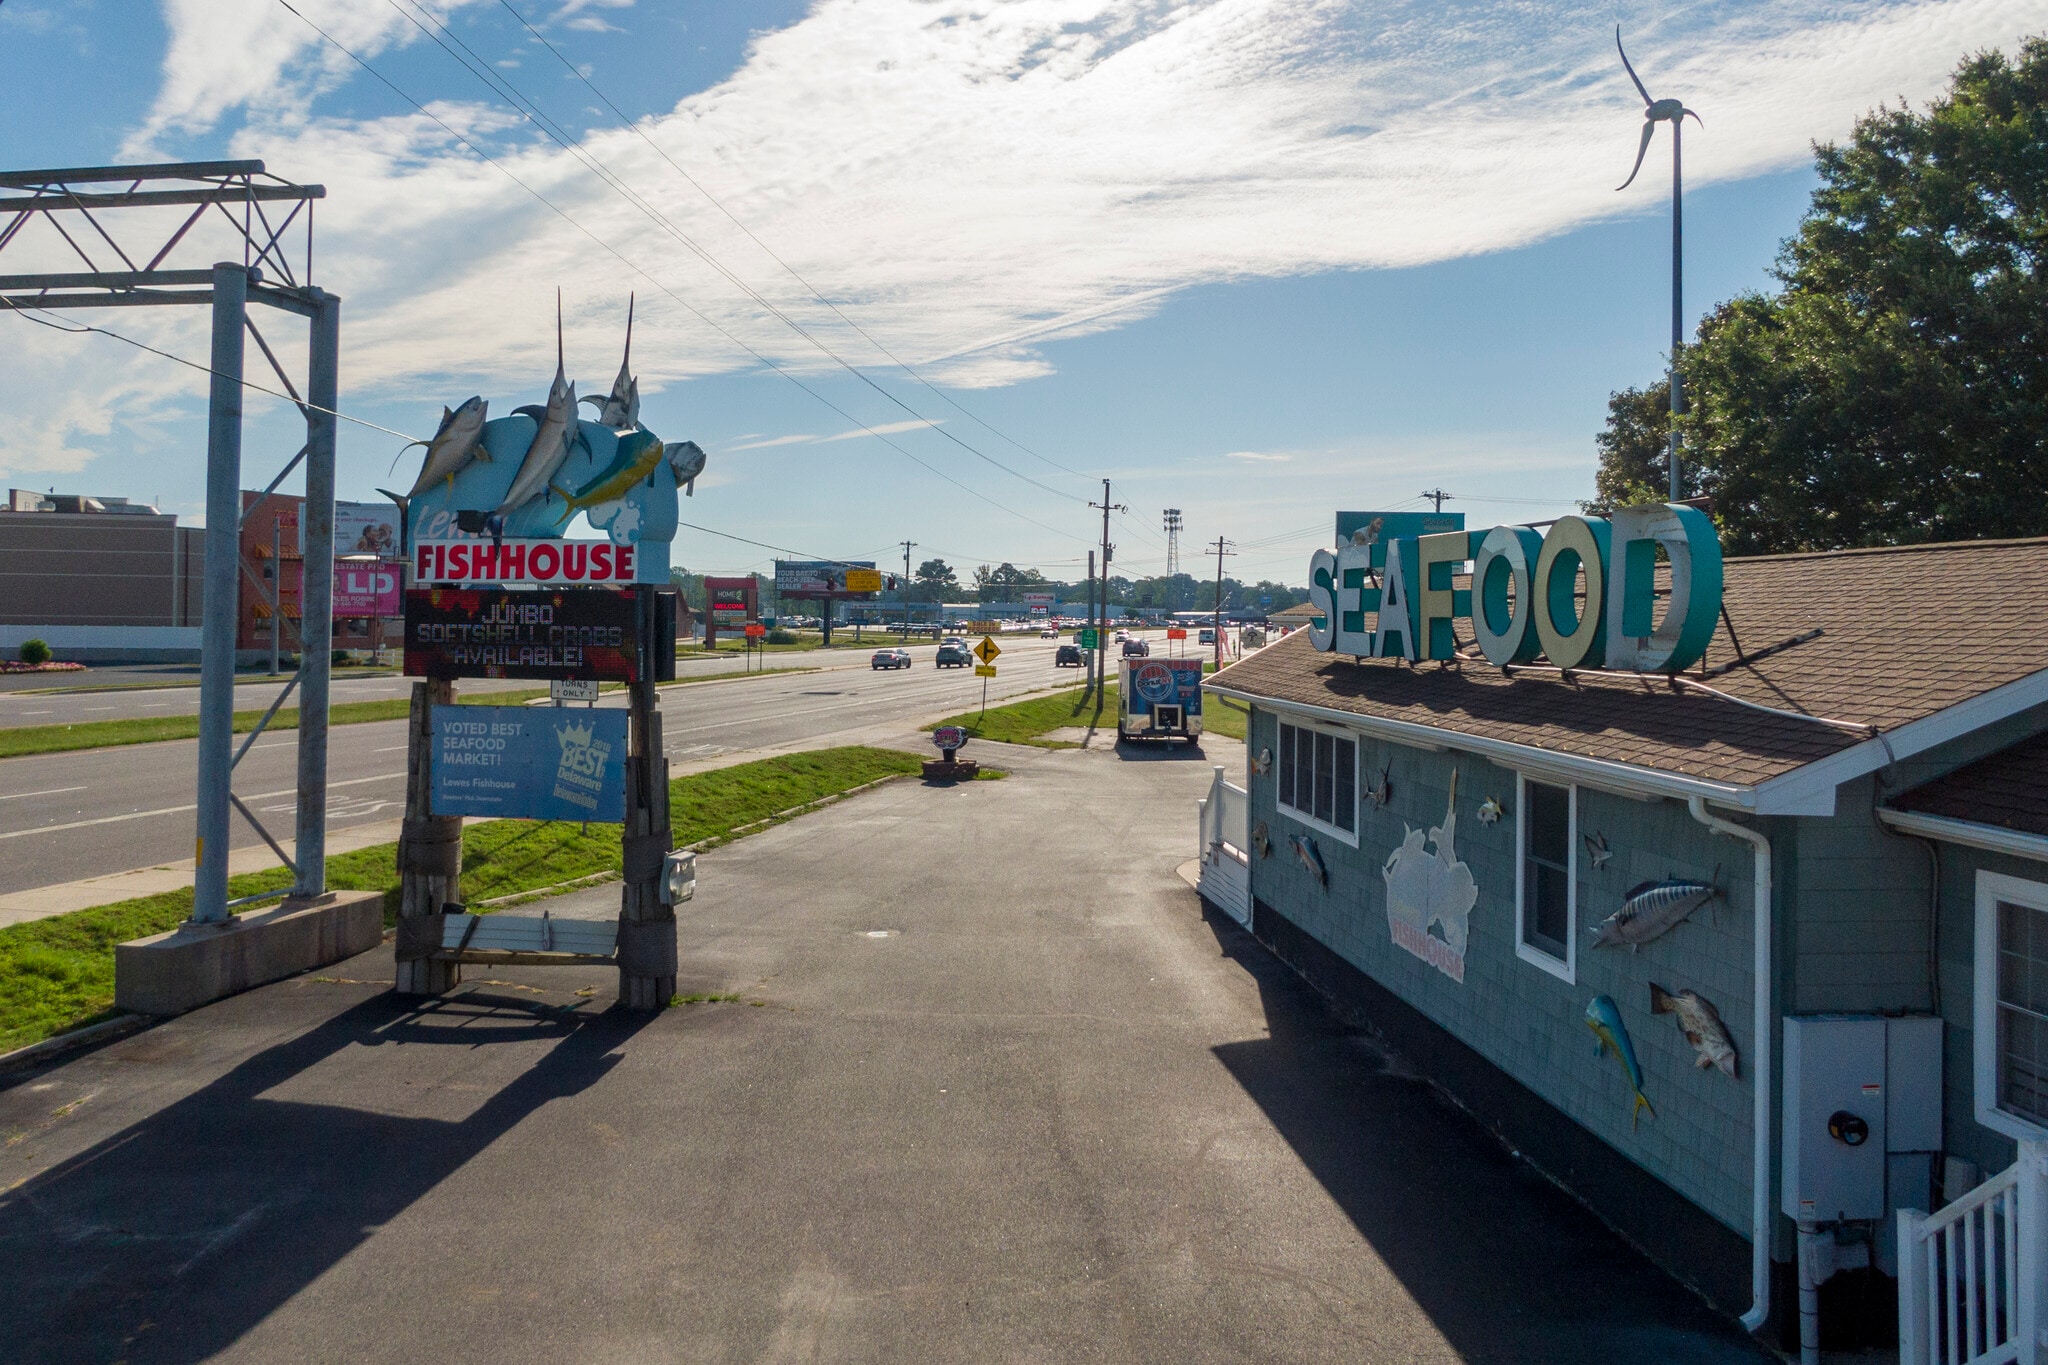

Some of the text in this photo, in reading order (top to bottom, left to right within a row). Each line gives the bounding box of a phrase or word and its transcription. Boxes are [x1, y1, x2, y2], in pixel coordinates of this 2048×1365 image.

[417, 543, 635, 581] FISHHOUSE
[1308, 503, 1720, 672] SEAFOOD
[482, 604, 553, 624] JUMBO
[417, 623, 623, 647] SOFTSHELL CRABS
[455, 647, 583, 667] AVAILABLE!
[563, 689, 585, 697] ONLY
[443, 722, 522, 736] VOTED BEST
[443, 737, 506, 750] SEAFOOD
[592, 739, 611, 752] 2018
[443, 753, 501, 766] MARKET!
[560, 746, 609, 779] BEST
[443, 777, 516, 789] Lewes Fishhouse
[557, 766, 602, 791] Delaware
